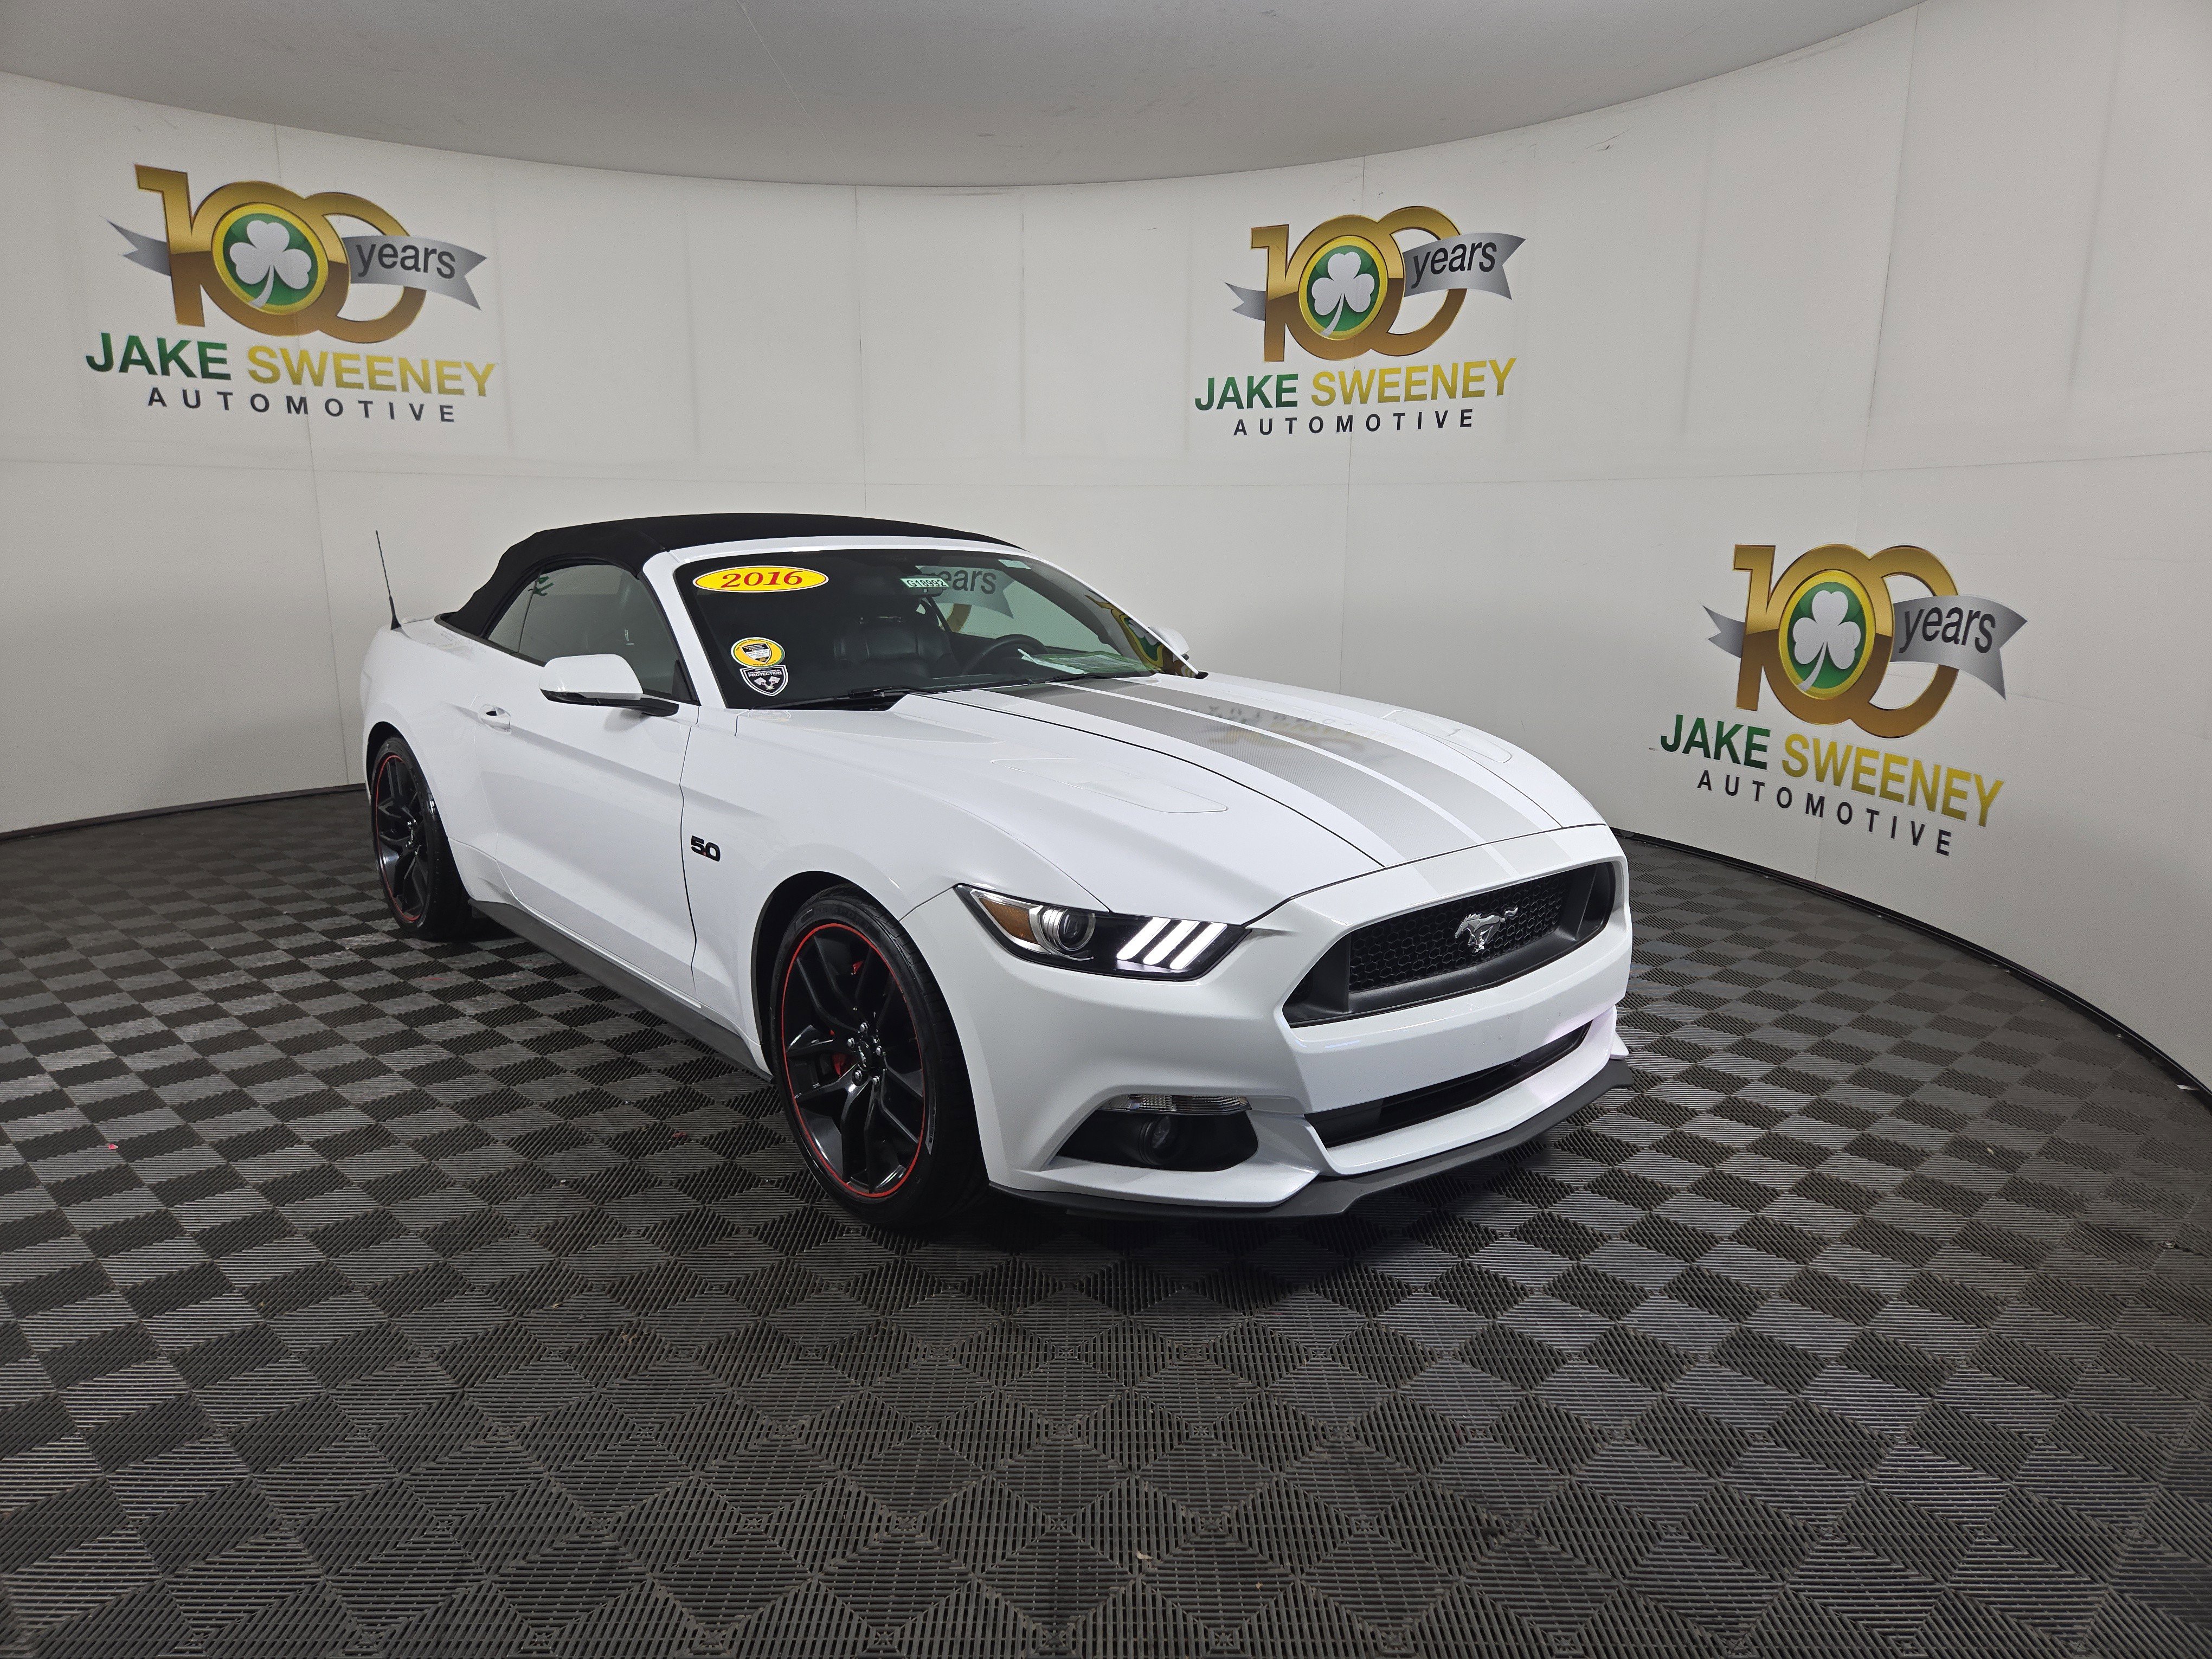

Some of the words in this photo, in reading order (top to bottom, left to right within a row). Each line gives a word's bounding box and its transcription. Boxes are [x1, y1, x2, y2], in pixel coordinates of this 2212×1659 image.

[134, 164, 427, 344] 100
[356, 239, 456, 279] years
[1411, 241, 1497, 290] years
[1251, 205, 1468, 362] 100
[85, 332, 232, 381] JAKE
[247, 345, 496, 397] SWEENEY
[1194, 374, 1298, 411] JAKE
[1311, 357, 1517, 407] SWEENEY
[147, 387, 455, 423] AUTOMOTIVE
[1233, 408, 1474, 436] AUTOMOTIVE
[721, 570, 803, 588] 2016
[906, 579, 947, 588] G18992
[1733, 544, 1960, 738] 100
[1899, 605, 1997, 654] years
[1660, 714, 1771, 770] JAKE
[1782, 733, 2004, 827] SWEENEY
[1697, 769, 1952, 857] AUTOMOTIVE
